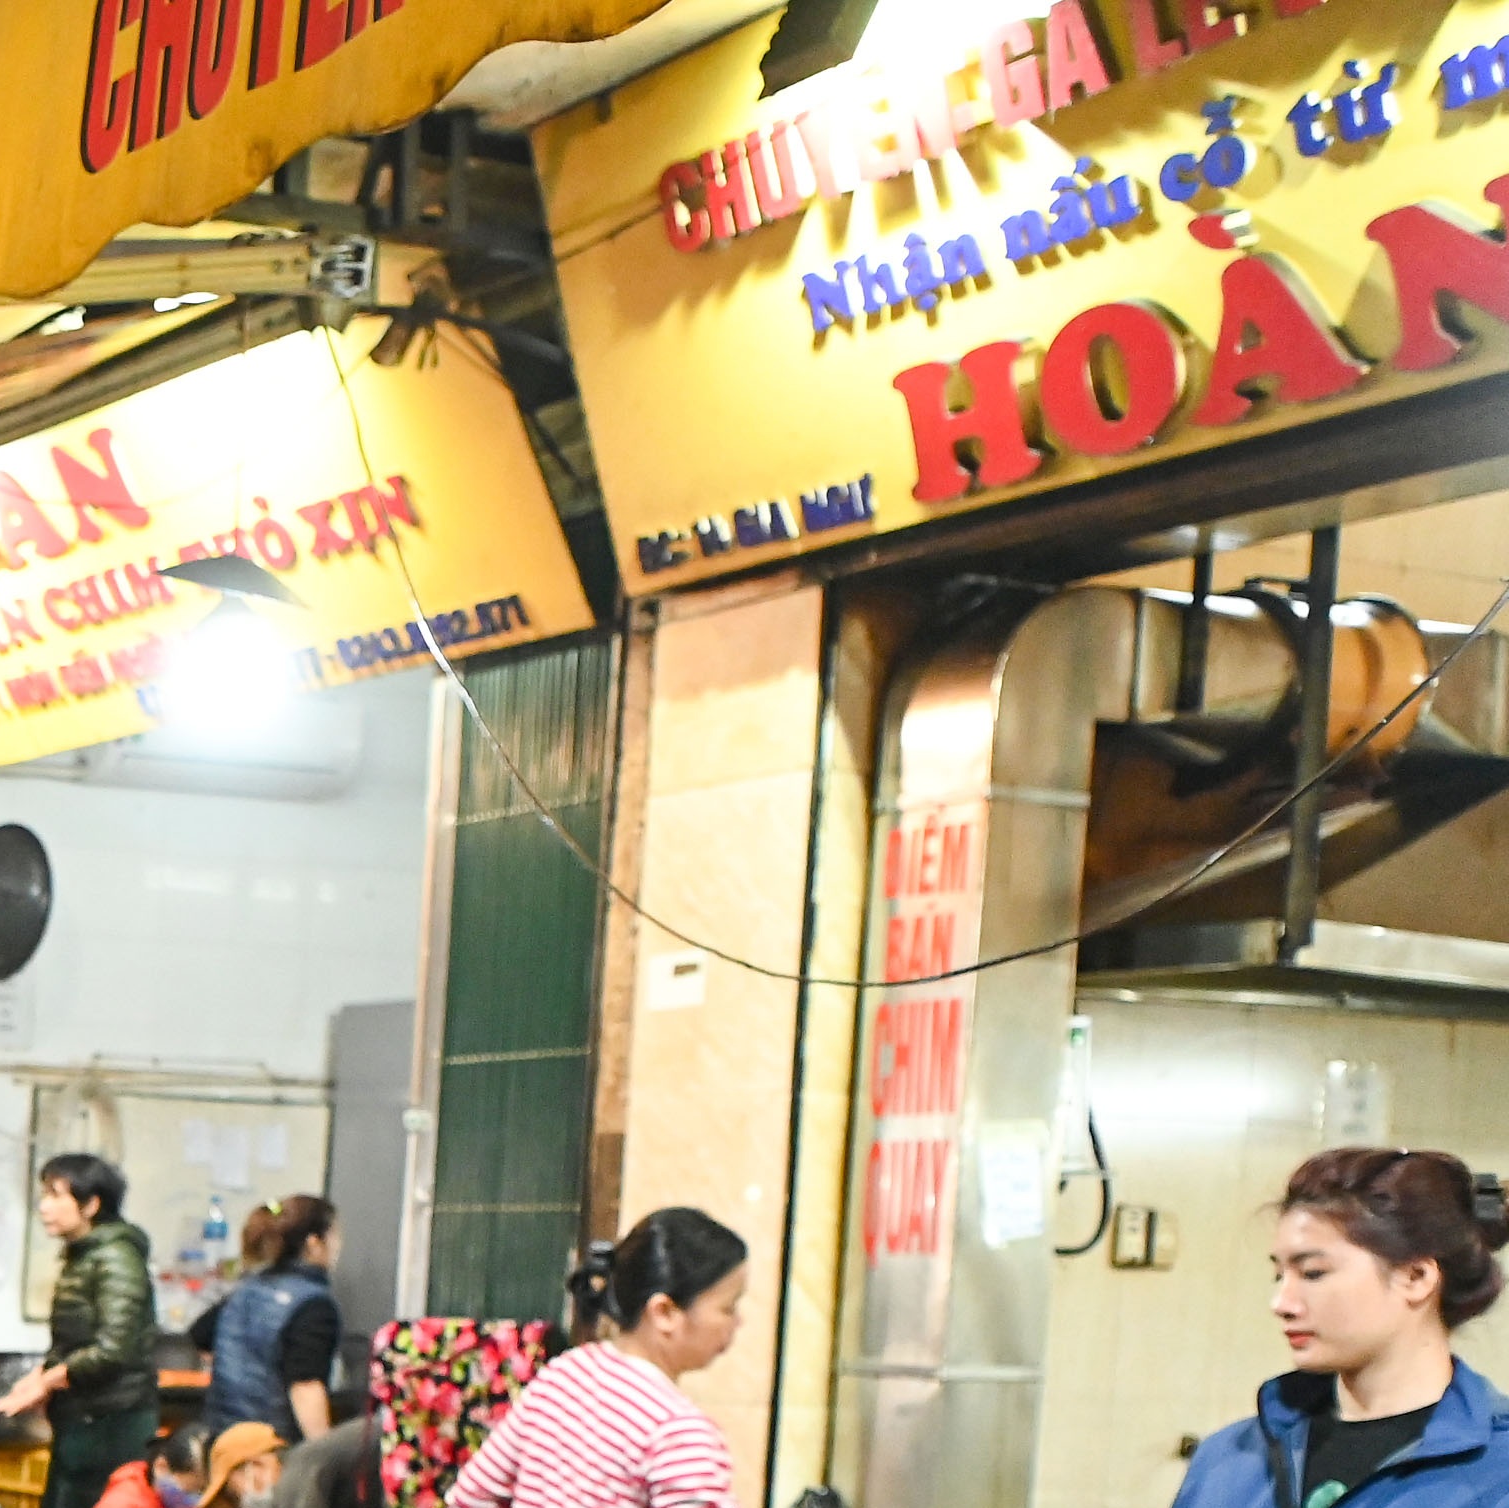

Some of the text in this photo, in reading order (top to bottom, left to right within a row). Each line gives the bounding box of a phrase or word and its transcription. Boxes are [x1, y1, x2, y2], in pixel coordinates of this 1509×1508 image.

[802, 233, 986, 332] Nhận
[1001, 156, 1139, 260] nấu
[1286, 60, 1397, 156] từ
[44, 556, 173, 632] CHIM
